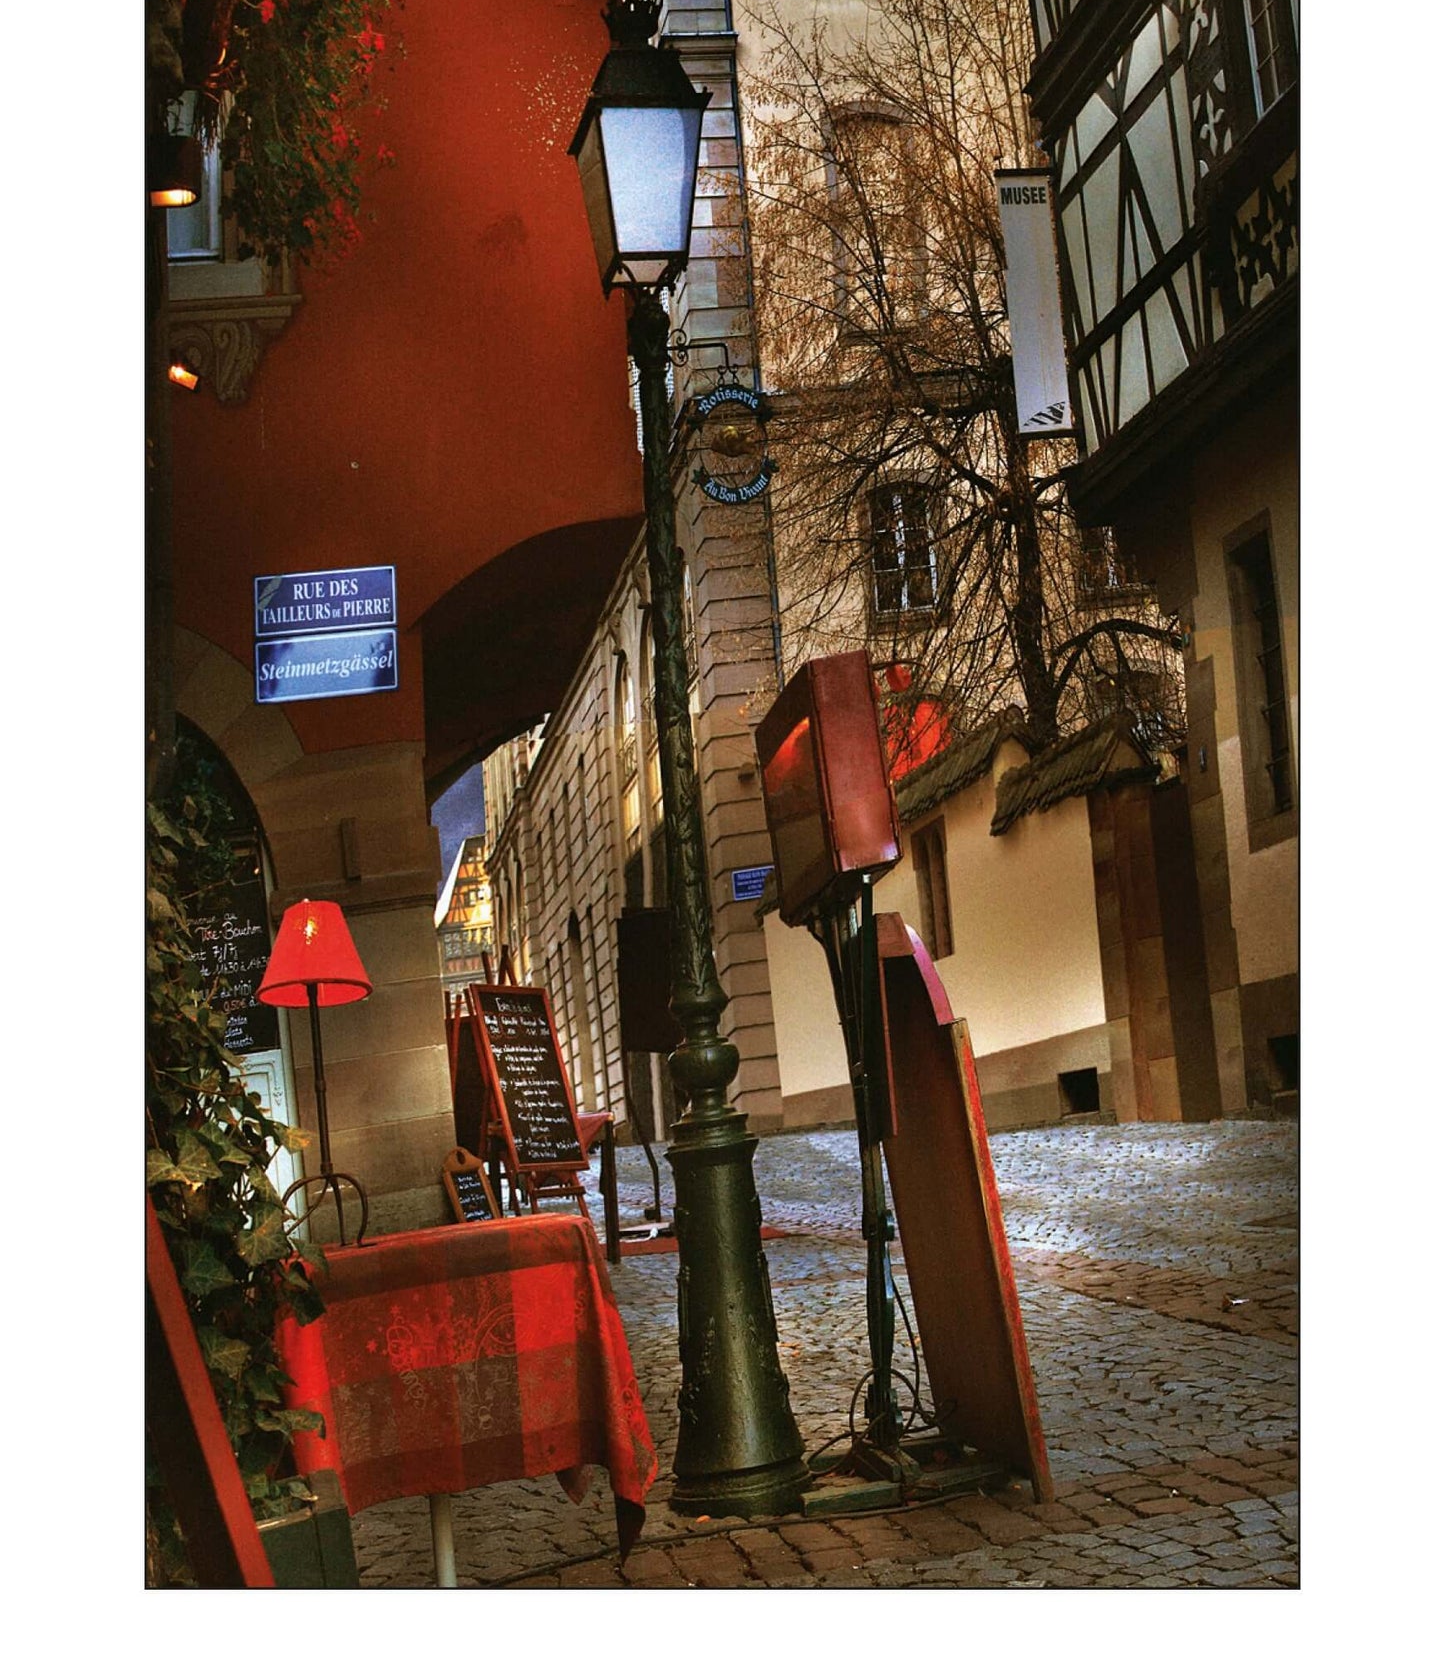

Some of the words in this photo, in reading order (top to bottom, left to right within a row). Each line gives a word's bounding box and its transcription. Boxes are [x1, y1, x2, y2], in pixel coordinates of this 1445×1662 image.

[1000, 186, 1047, 205] MUSEE
[704, 478, 718, 496] Au
[718, 487, 737, 502] Bon
[293, 581, 325, 601] RUE
[329, 578, 359, 597] DES
[262, 602, 331, 625] TAILLEURS
[343, 598, 391, 617] PIERRE
[260, 651, 393, 681] Steinmetzgässel
